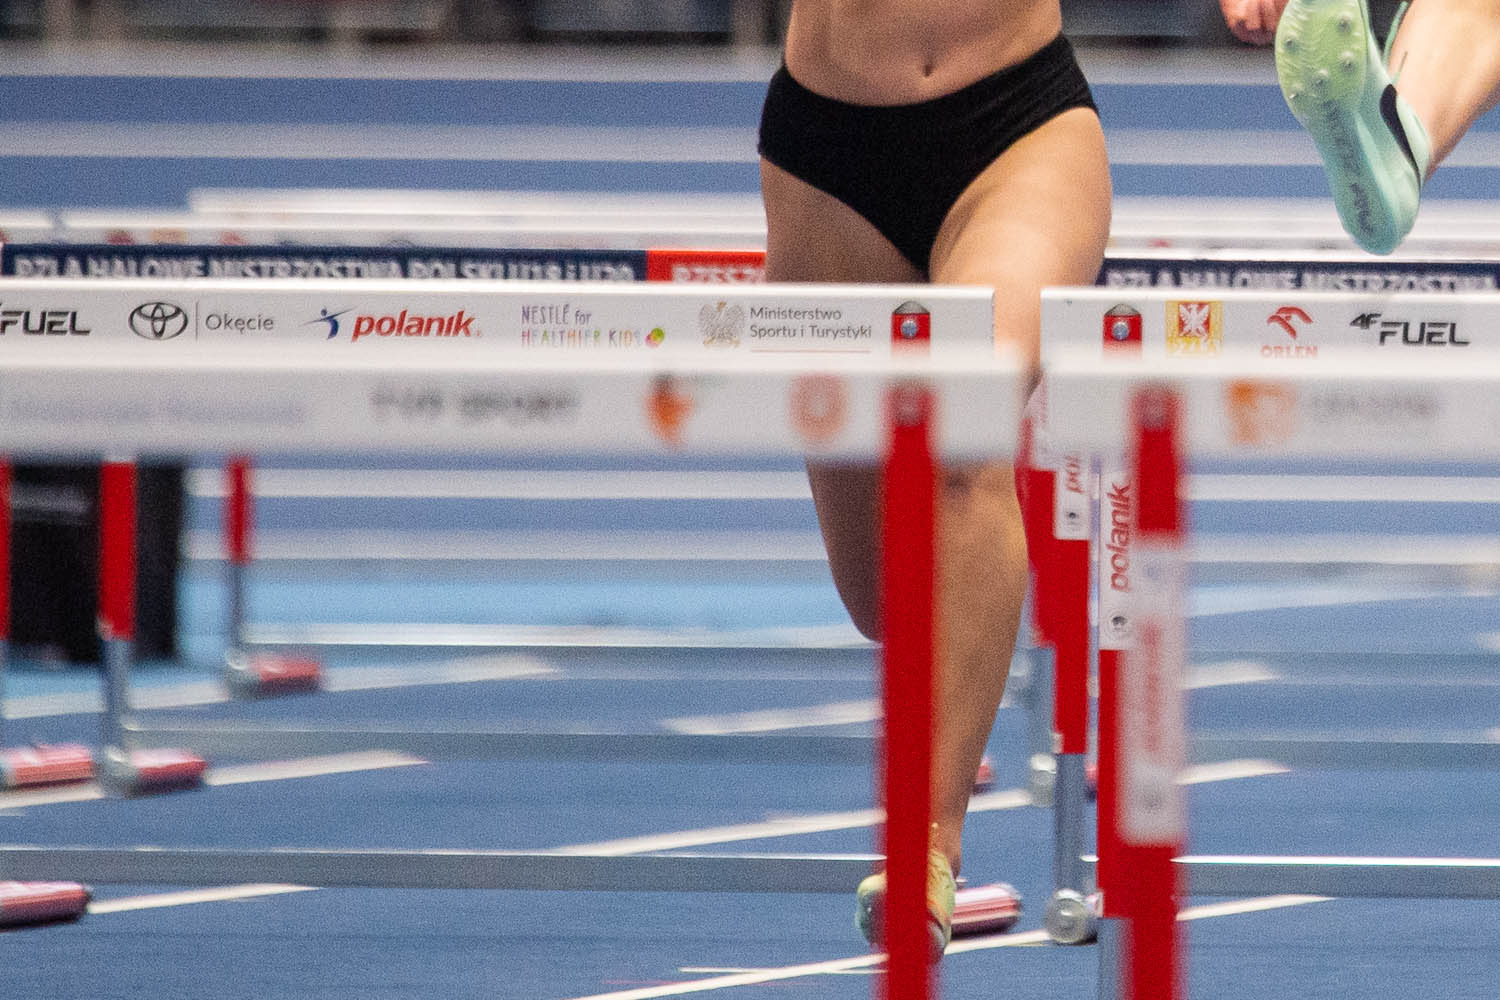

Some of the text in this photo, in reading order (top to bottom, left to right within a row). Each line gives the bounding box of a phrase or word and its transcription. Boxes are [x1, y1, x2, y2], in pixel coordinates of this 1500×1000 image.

[0, 310, 91, 336] FUEL
[205, 313, 275, 334] Okęcie
[521, 304, 592, 326] NESTLÉ for
[750, 307, 842, 321] Ministerstwo
[351, 309, 477, 343] polanik
[750, 324, 797, 340] Sportu
[808, 324, 873, 340] Turystyki
[1379, 321, 1471, 347] FUEL
[1261, 345, 1319, 359] ORLEN
[1110, 481, 1131, 593] polanik
